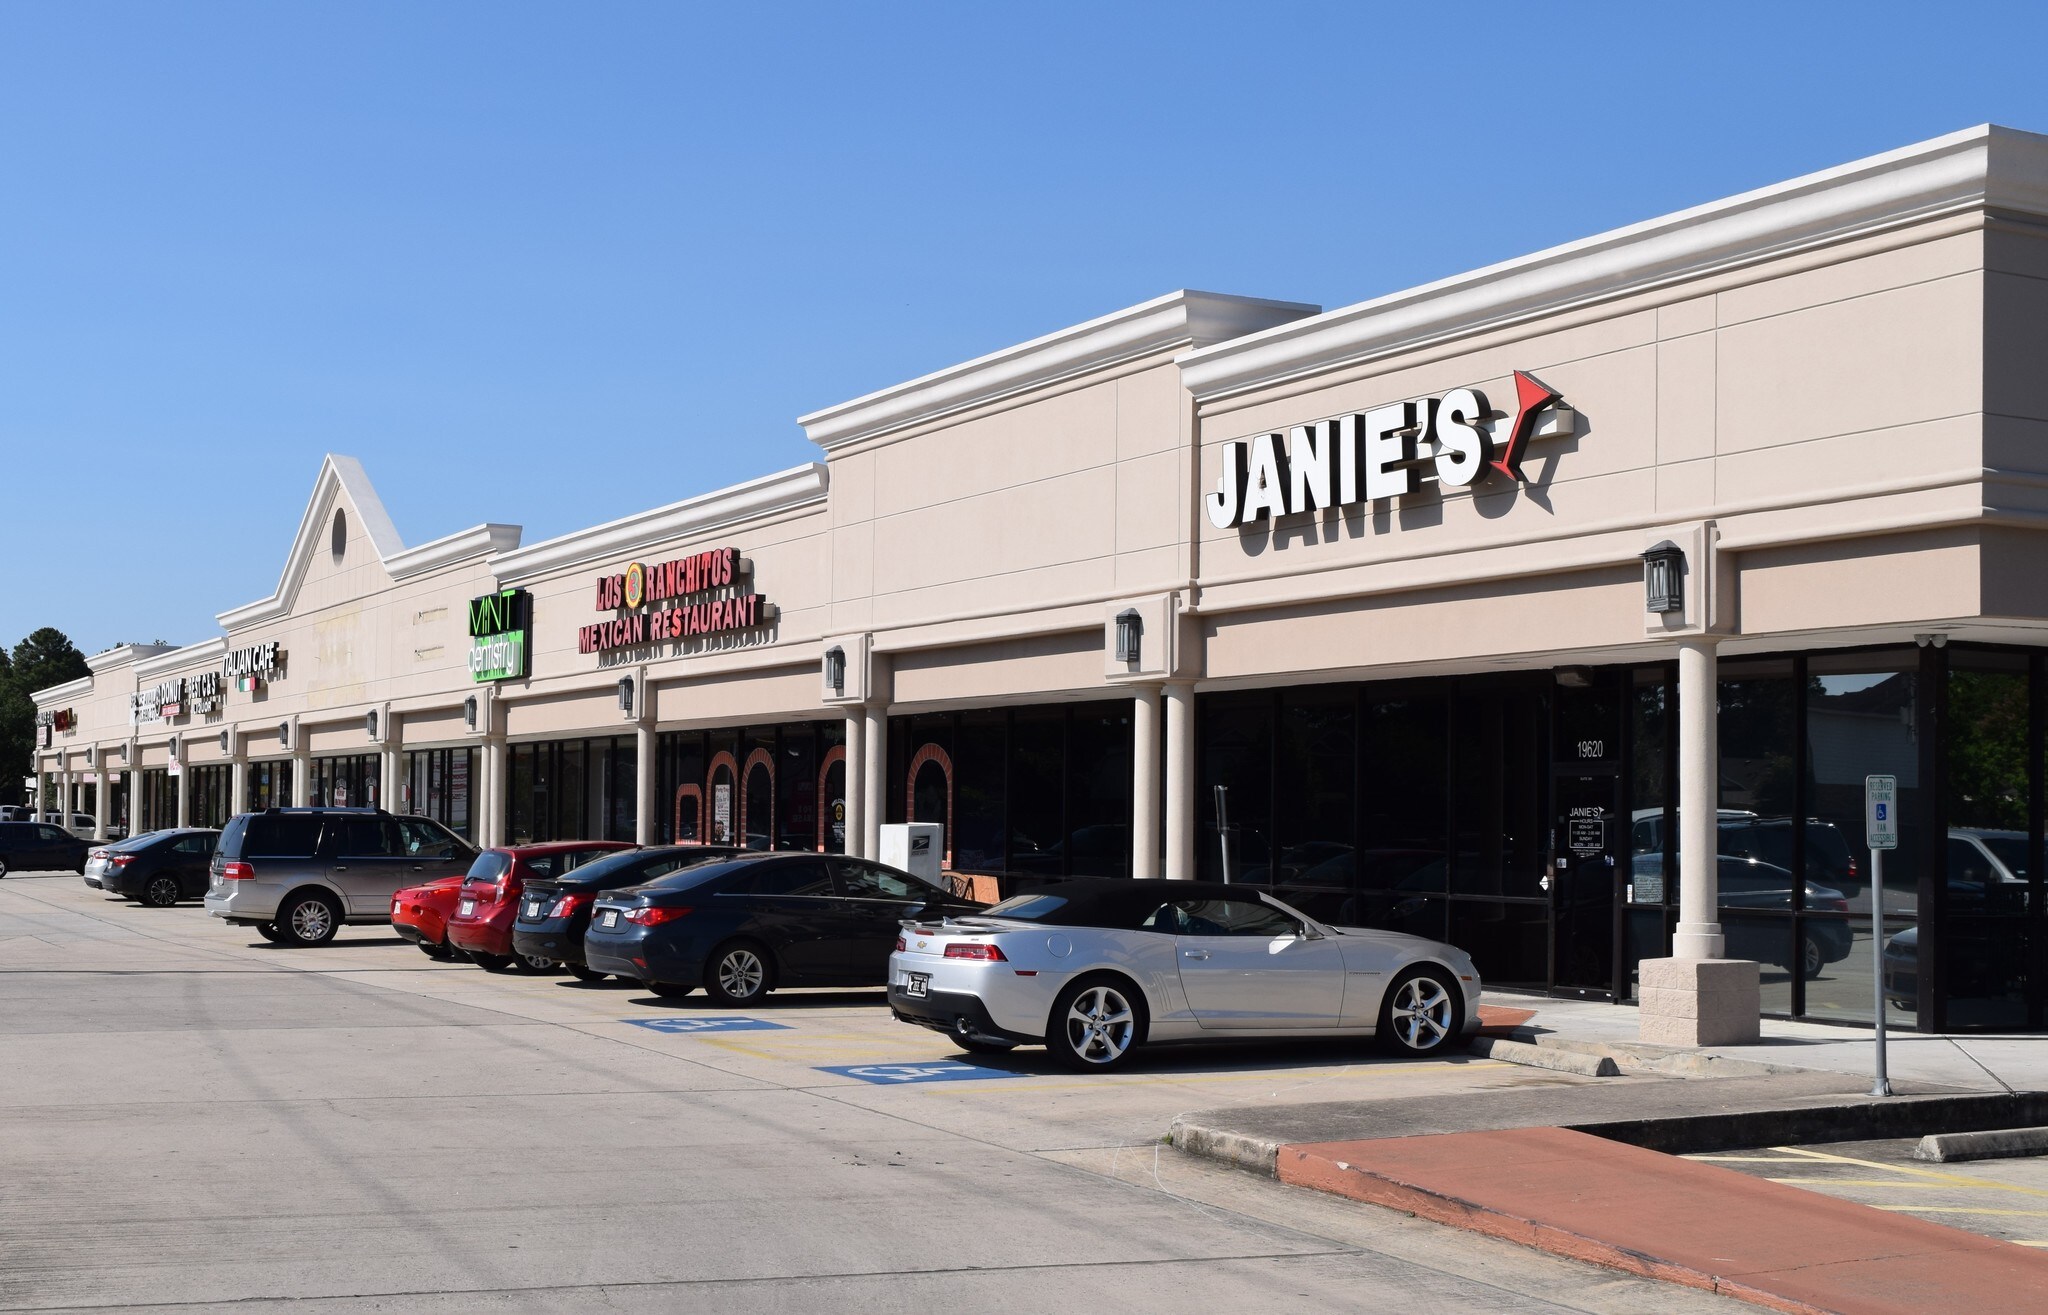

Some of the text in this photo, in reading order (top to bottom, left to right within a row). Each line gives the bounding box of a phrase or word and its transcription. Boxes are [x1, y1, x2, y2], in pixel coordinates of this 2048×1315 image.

[1205, 388, 1486, 529] JANIE'S
[596, 573, 623, 611] LOS
[646, 547, 734, 602] RANCHITOS
[579, 594, 758, 654] MEXICAN RESTAURANT
[222, 642, 275, 677] ITALIAN CAFE
[468, 635, 515, 676] dentistry
[161, 679, 183, 705] DONUT
[1577, 740, 1603, 758] 19620
[1869, 781, 1893, 791] RESERVED
[1871, 791, 1891, 801] PARKING
[1569, 807, 1599, 817] JANIE'S
[1870, 833, 1895, 843] ACCESSIBLE
[1876, 823, 1887, 833] VAN
